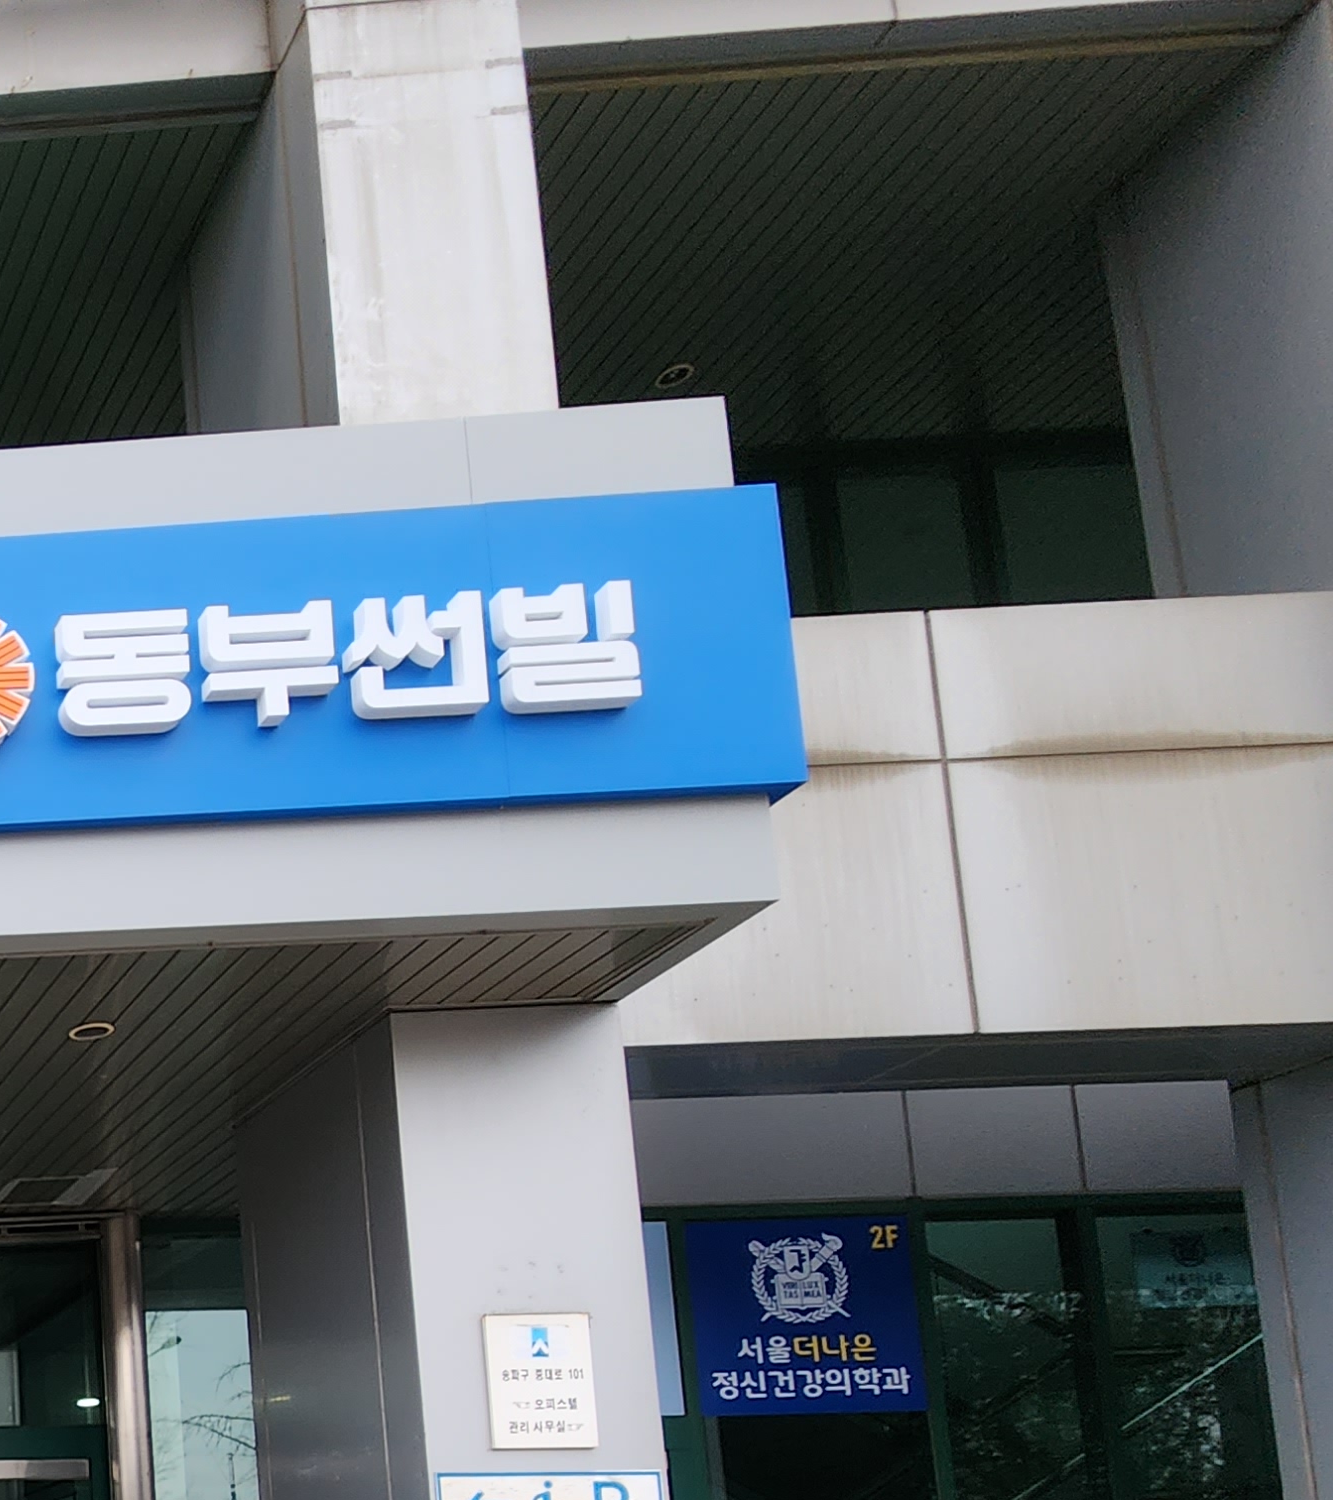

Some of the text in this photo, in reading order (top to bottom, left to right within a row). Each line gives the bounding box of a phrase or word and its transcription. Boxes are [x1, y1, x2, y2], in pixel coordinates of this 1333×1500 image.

[56, 579, 645, 737] 동부썬빌
[869, 1225, 899, 1249] 2F
[737, 1333, 878, 1364] 서울더나은
[501, 1368, 530, 1382] 송파구
[568, 1368, 585, 1380] 101
[711, 1366, 912, 1401] 정신건강의학과
[534, 1397, 578, 1411] 오피스텔
[508, 1420, 566, 1434] 관리 사무실
